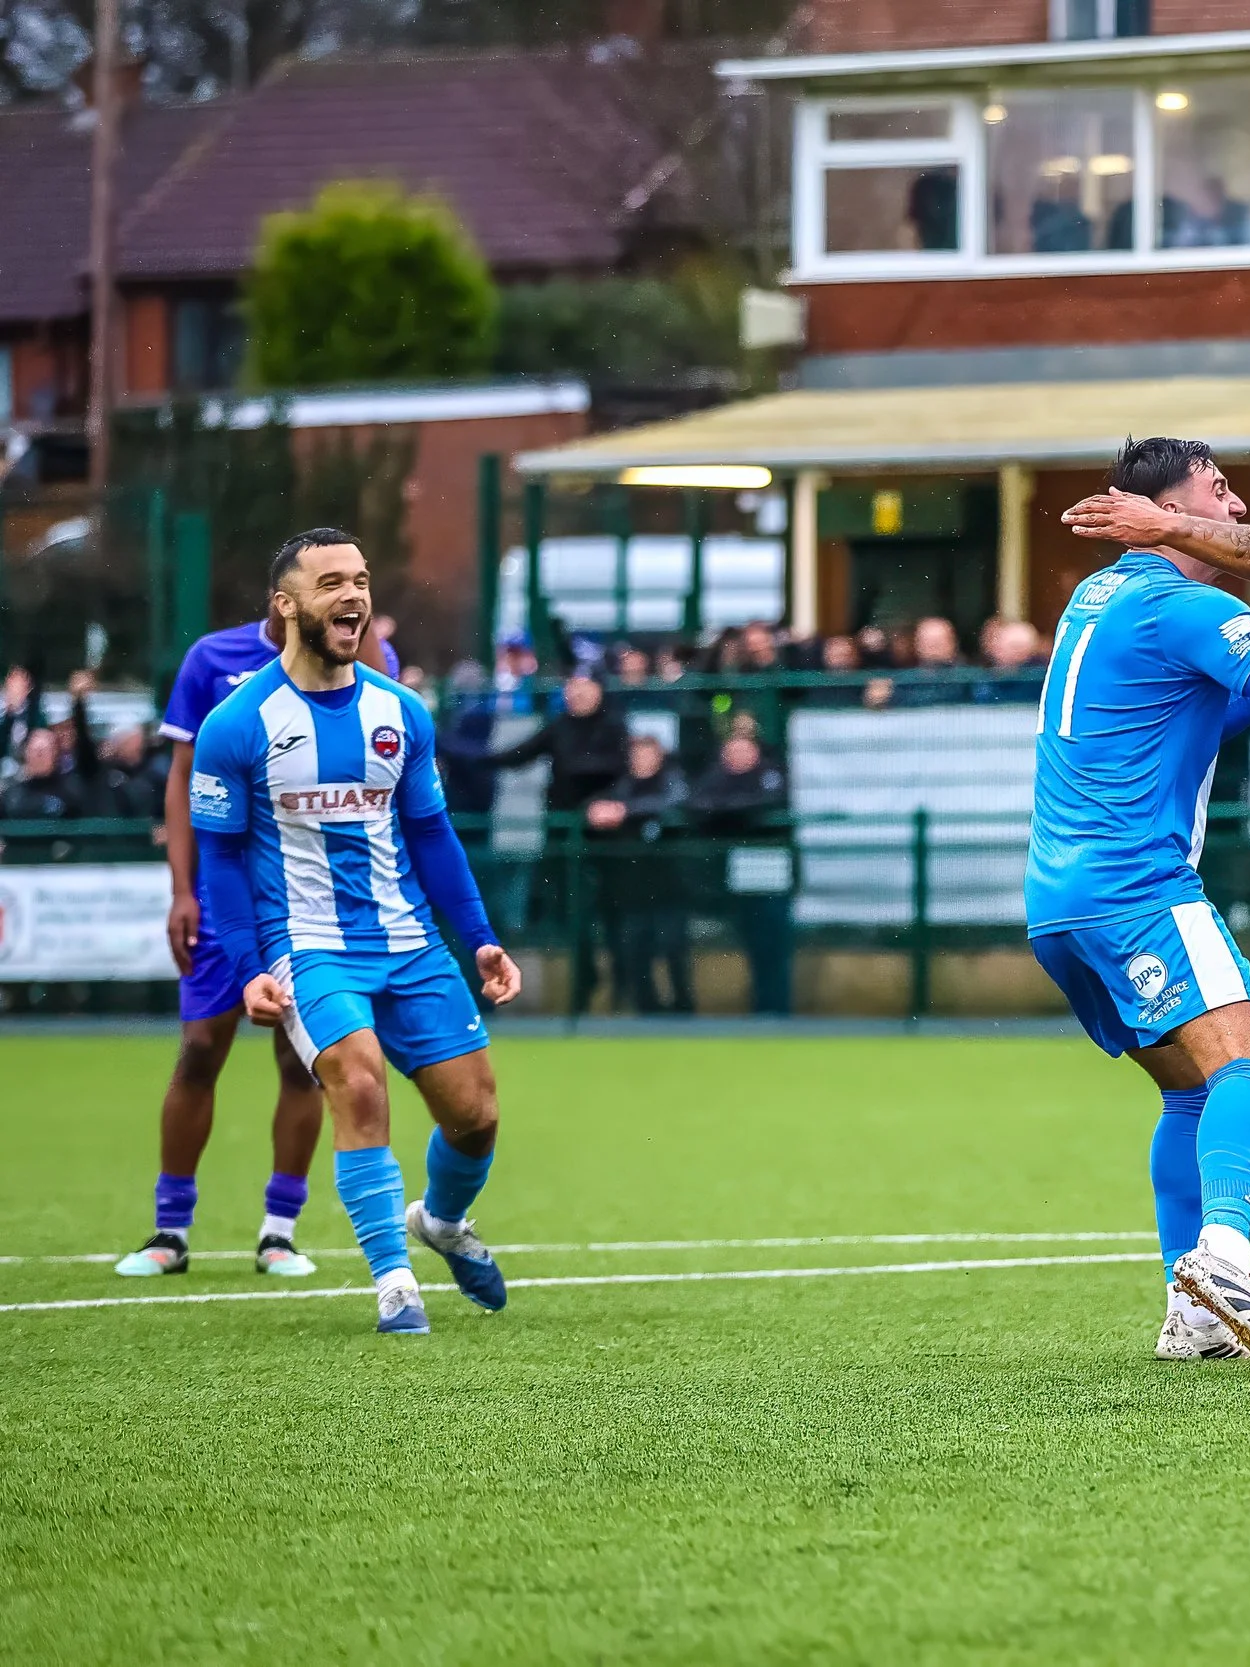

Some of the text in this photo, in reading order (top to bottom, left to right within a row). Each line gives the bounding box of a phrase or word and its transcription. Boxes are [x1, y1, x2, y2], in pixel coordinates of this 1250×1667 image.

[1036, 622, 1097, 737] 11
[279, 788, 394, 810] STUART
[1161, 981, 1189, 1000] ADVICE
